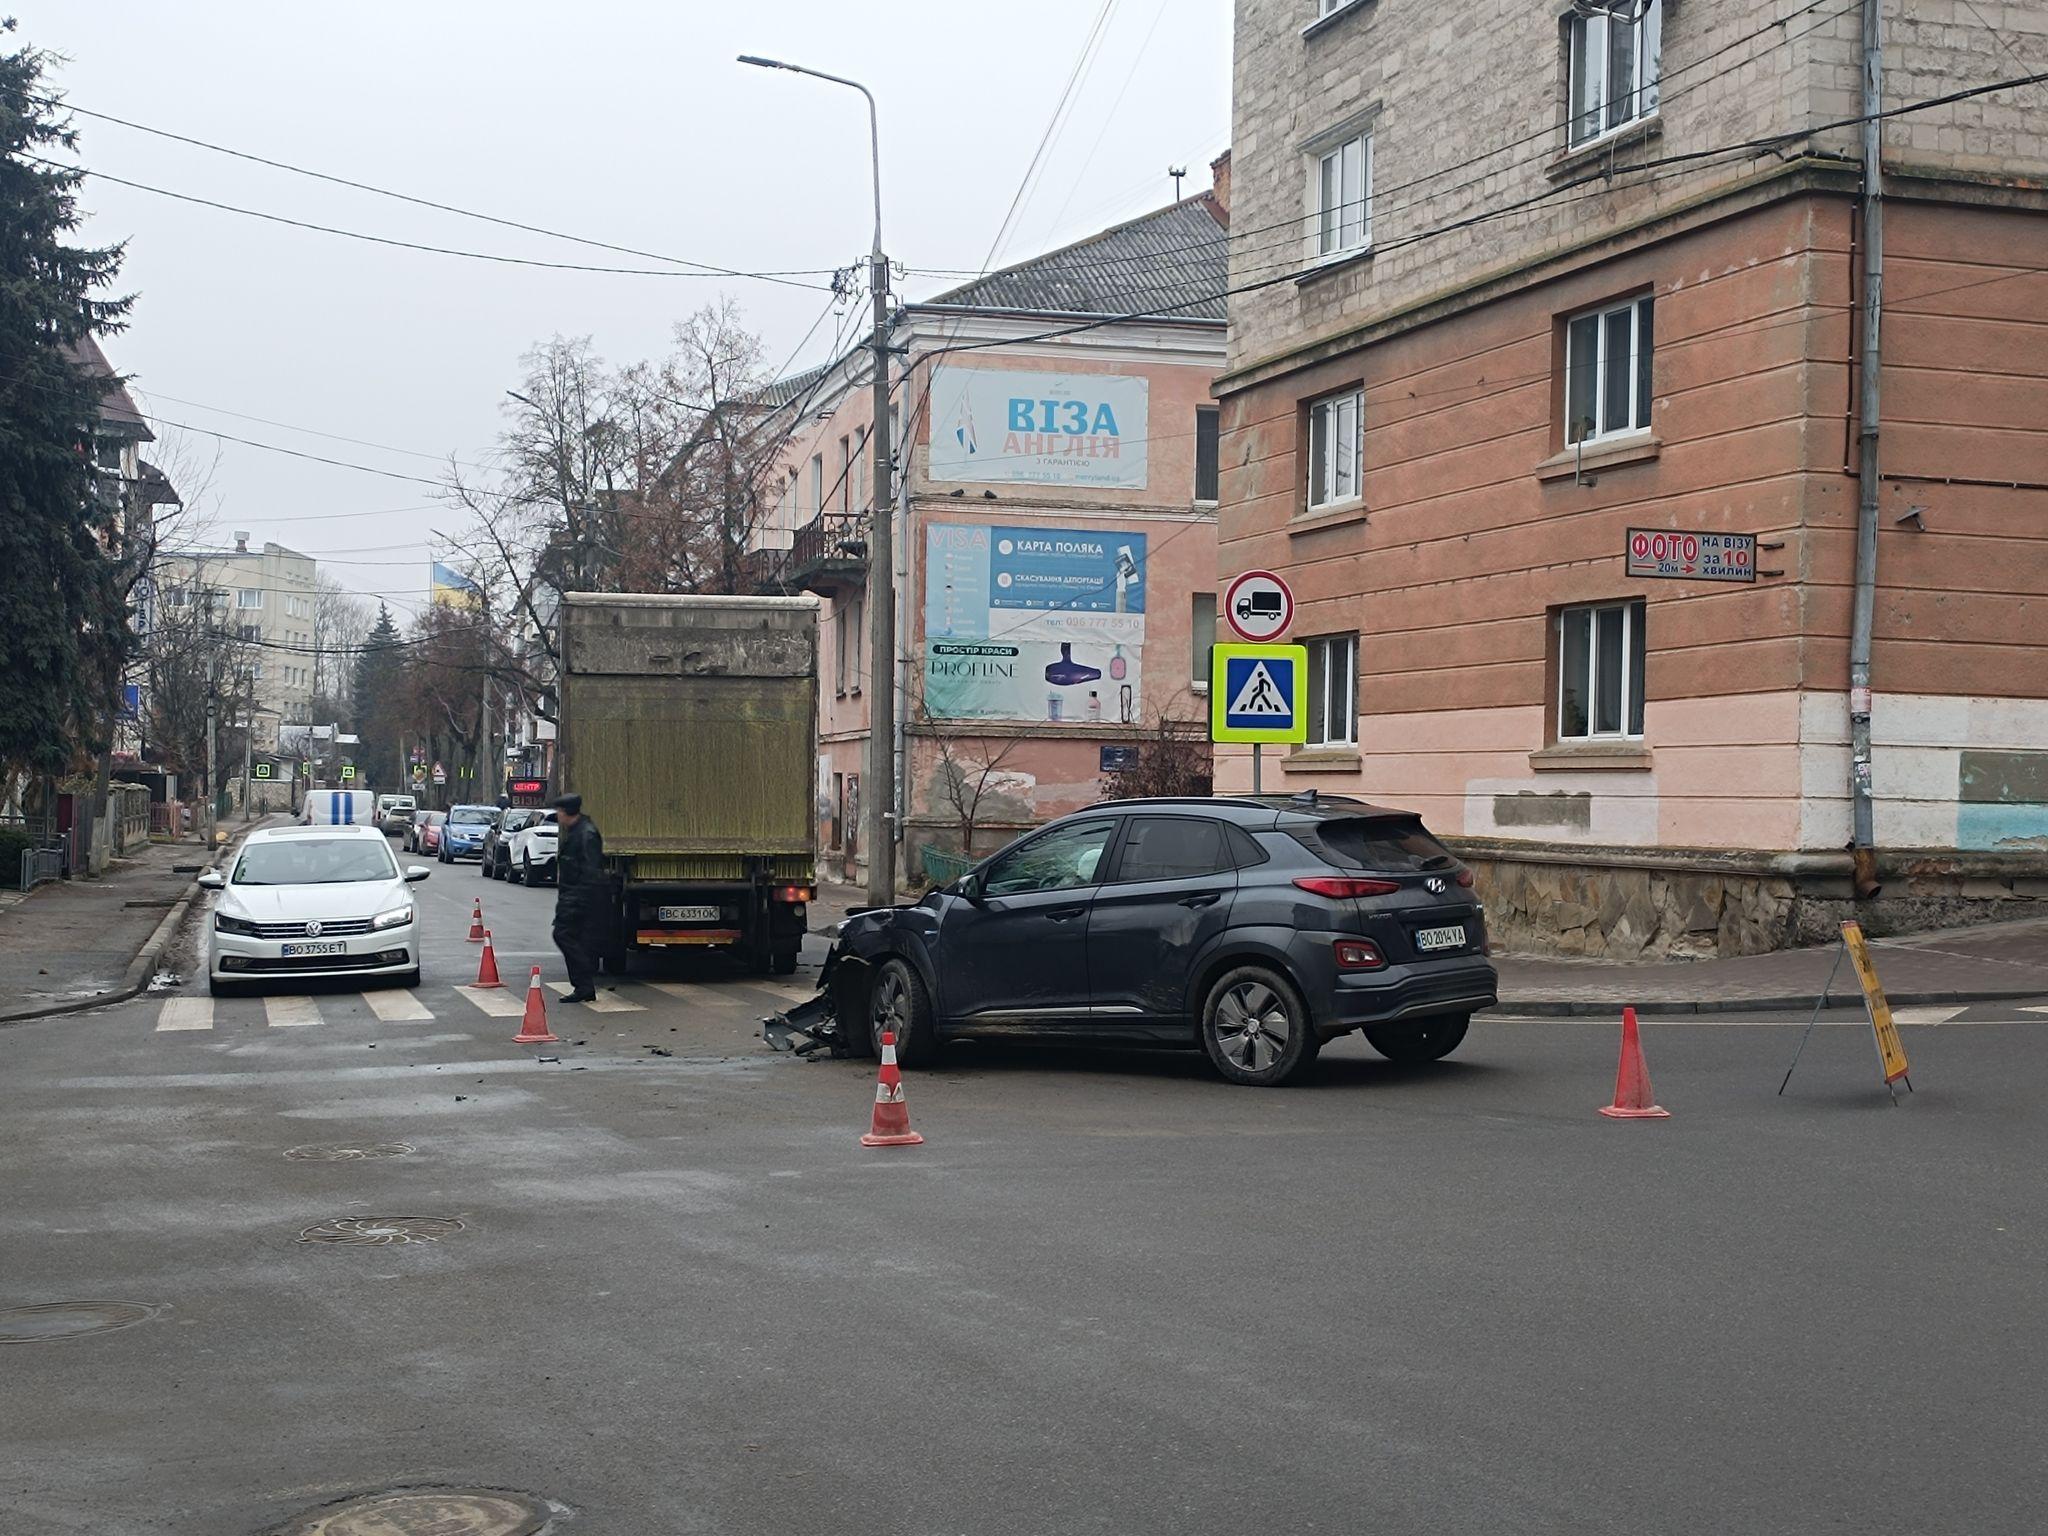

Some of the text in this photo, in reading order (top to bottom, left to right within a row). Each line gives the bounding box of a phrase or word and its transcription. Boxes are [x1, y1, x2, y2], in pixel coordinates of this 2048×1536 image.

[1008, 399, 1119, 436] ВІЗА
[1003, 432, 1120, 459] АНГЛІЯ
[929, 527, 988, 551] VISA
[1702, 536, 1751, 549] НА ВІЗУ
[1017, 540, 1104, 554] КАРТА ПОЛЯКА
[1631, 533, 1700, 563] ФОТО
[1704, 550, 1749, 567] за 10
[1658, 563, 1679, 574] 20м
[1702, 567, 1751, 577] хвилин
[1015, 575, 1104, 586] СКАСУВАННЯ ДЕПОРТАЦІЇ
[940, 645, 1013, 656] ПРОСТІР КРАСИ
